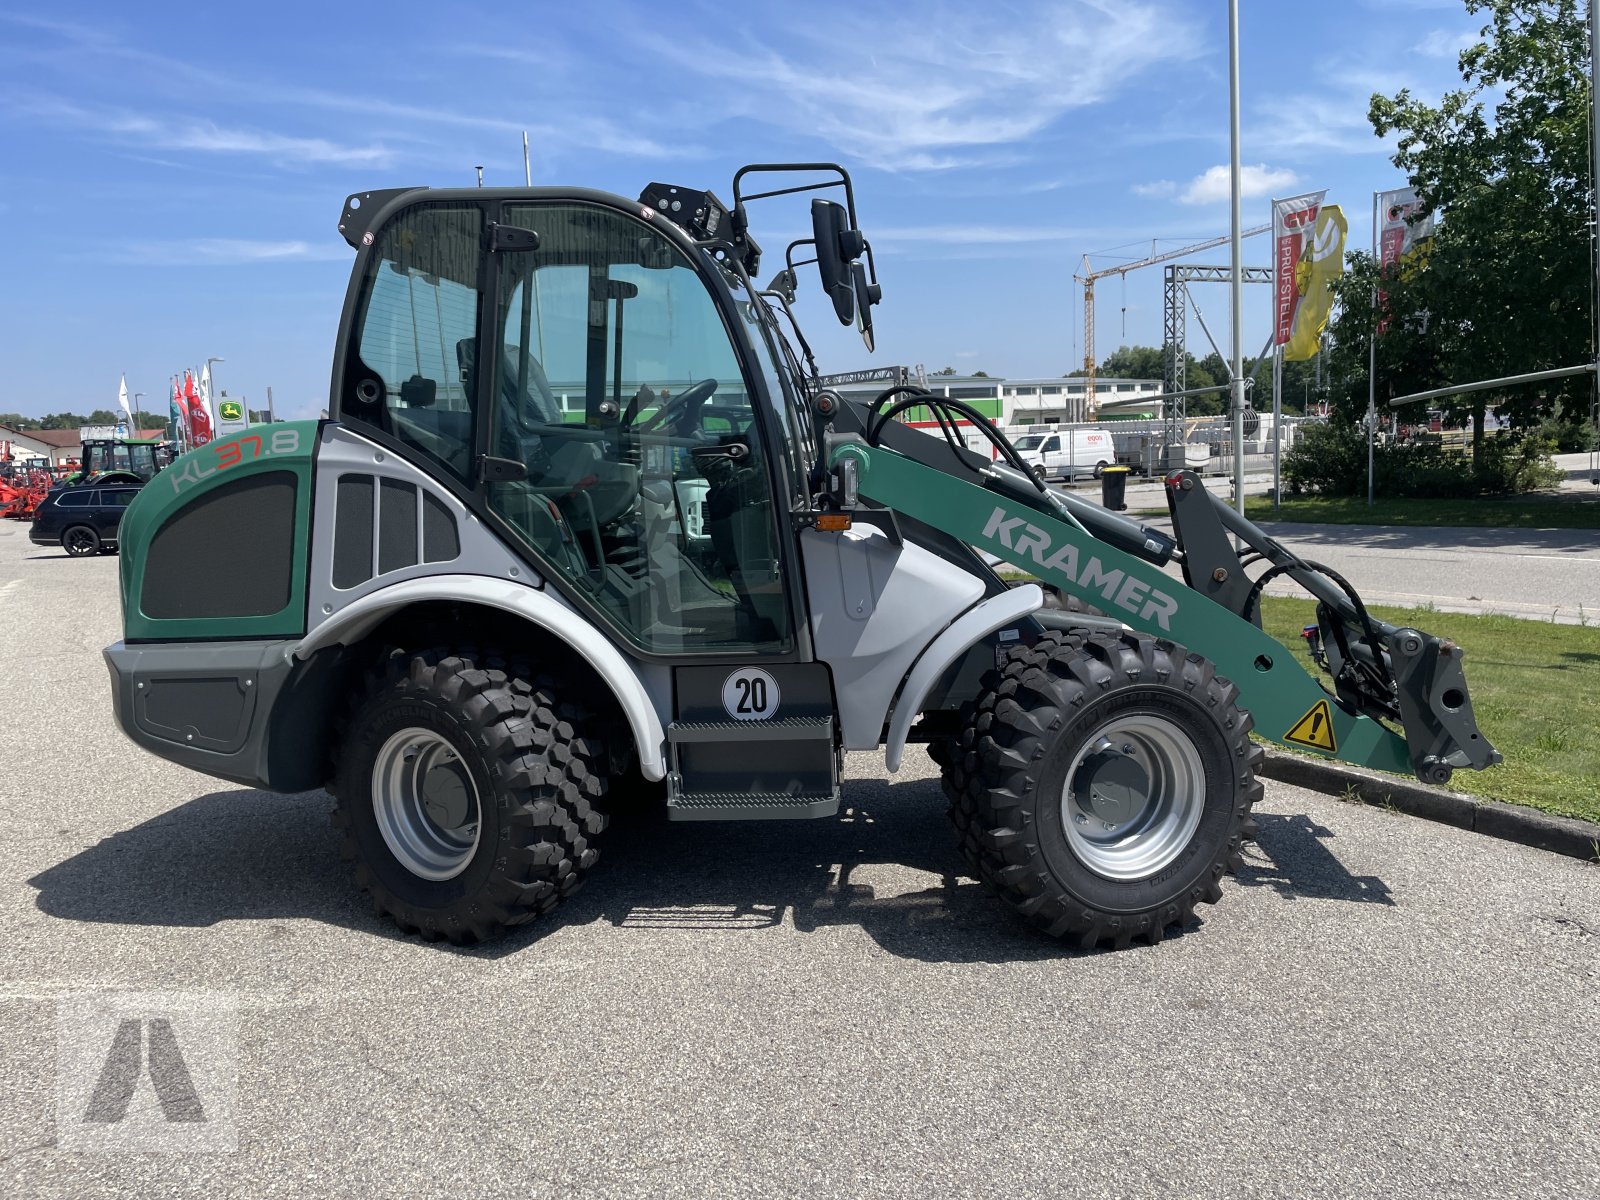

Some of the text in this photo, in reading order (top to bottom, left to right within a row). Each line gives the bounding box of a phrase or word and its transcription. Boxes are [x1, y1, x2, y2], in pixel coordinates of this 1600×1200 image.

[1280, 246, 1293, 337] PRÜFSTELLE
[982, 506, 1179, 632] KRAMER
[735, 677, 767, 713] 20
